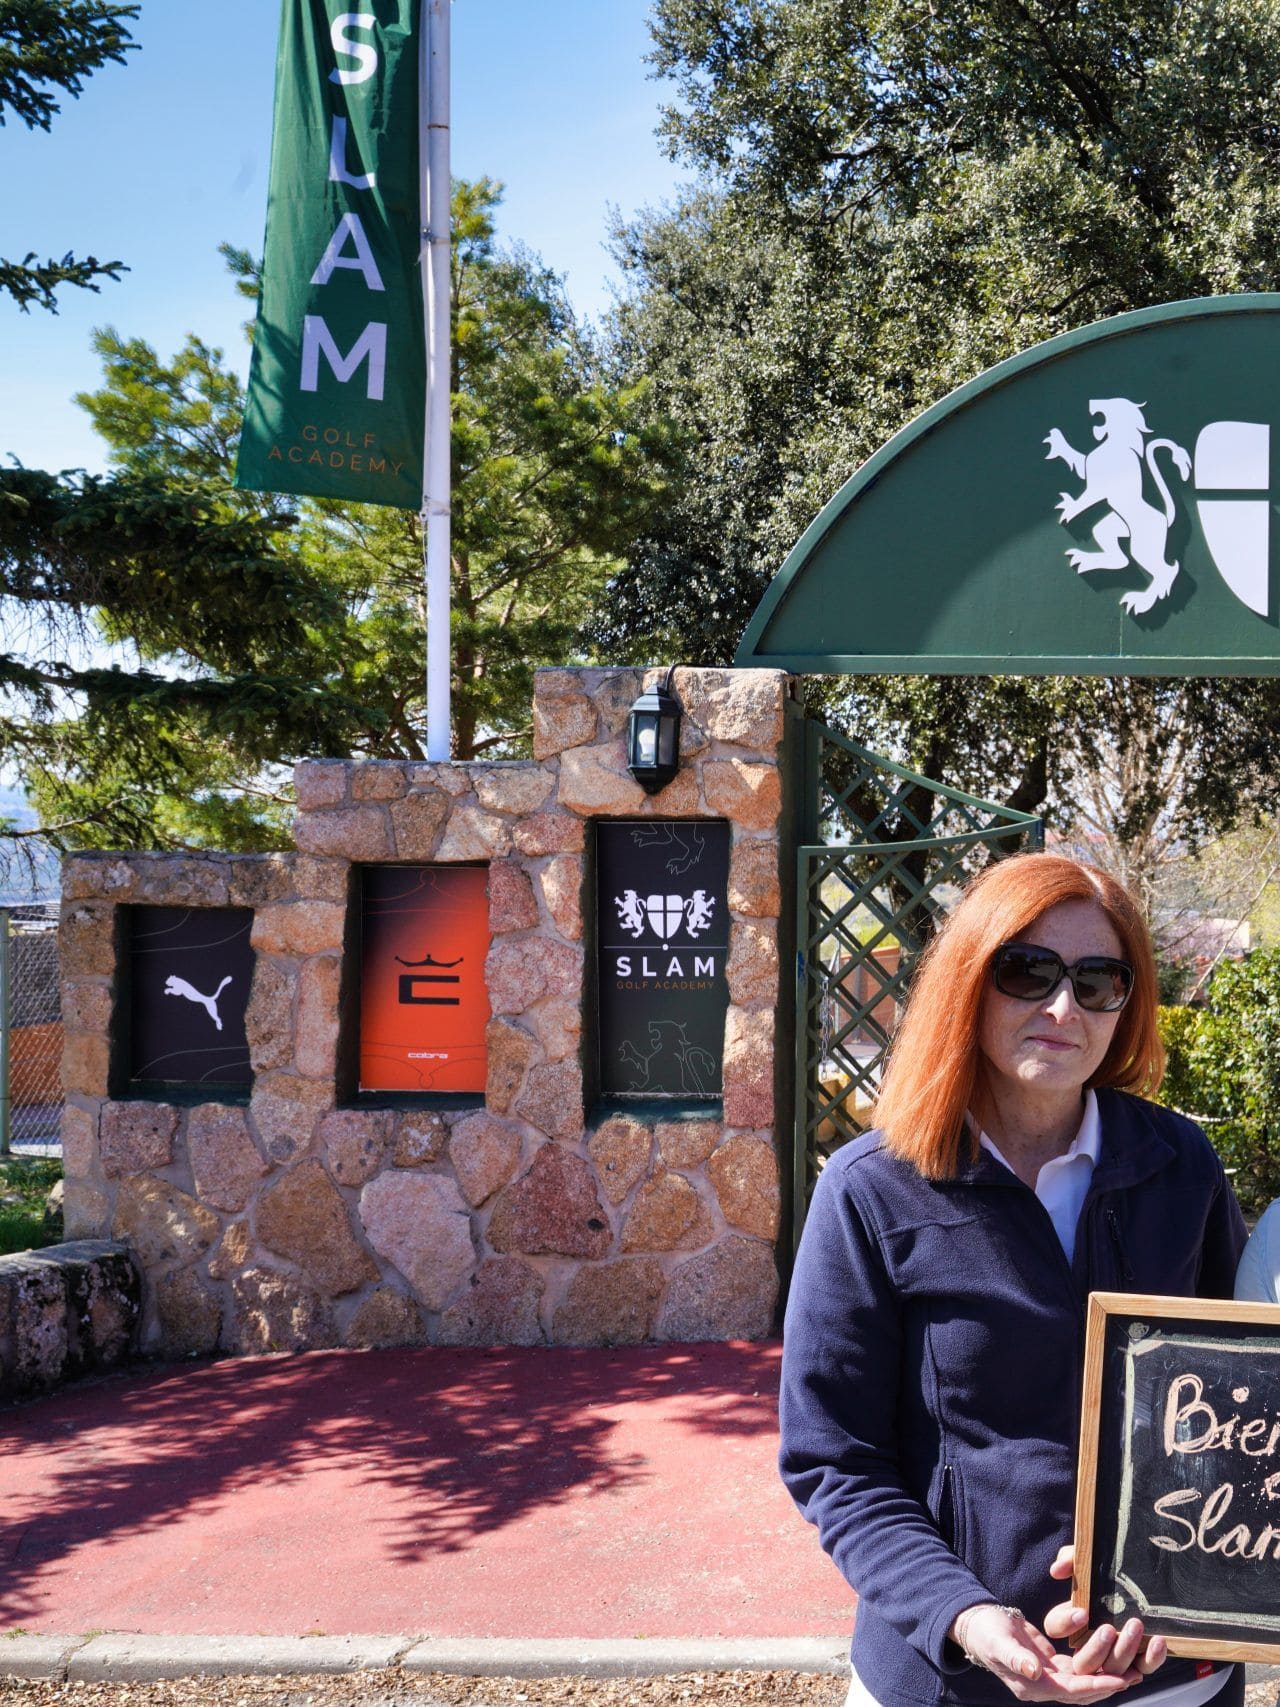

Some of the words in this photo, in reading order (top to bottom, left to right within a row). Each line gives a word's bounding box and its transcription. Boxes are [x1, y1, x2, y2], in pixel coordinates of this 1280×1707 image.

[300, 13, 388, 401] SLAM
[302, 424, 377, 449] GOLF
[267, 444, 403, 476] ACADEMY
[616, 956, 715, 977] SLAM
[616, 981, 649, 990] GOLF
[654, 981, 715, 990] ACADEMY
